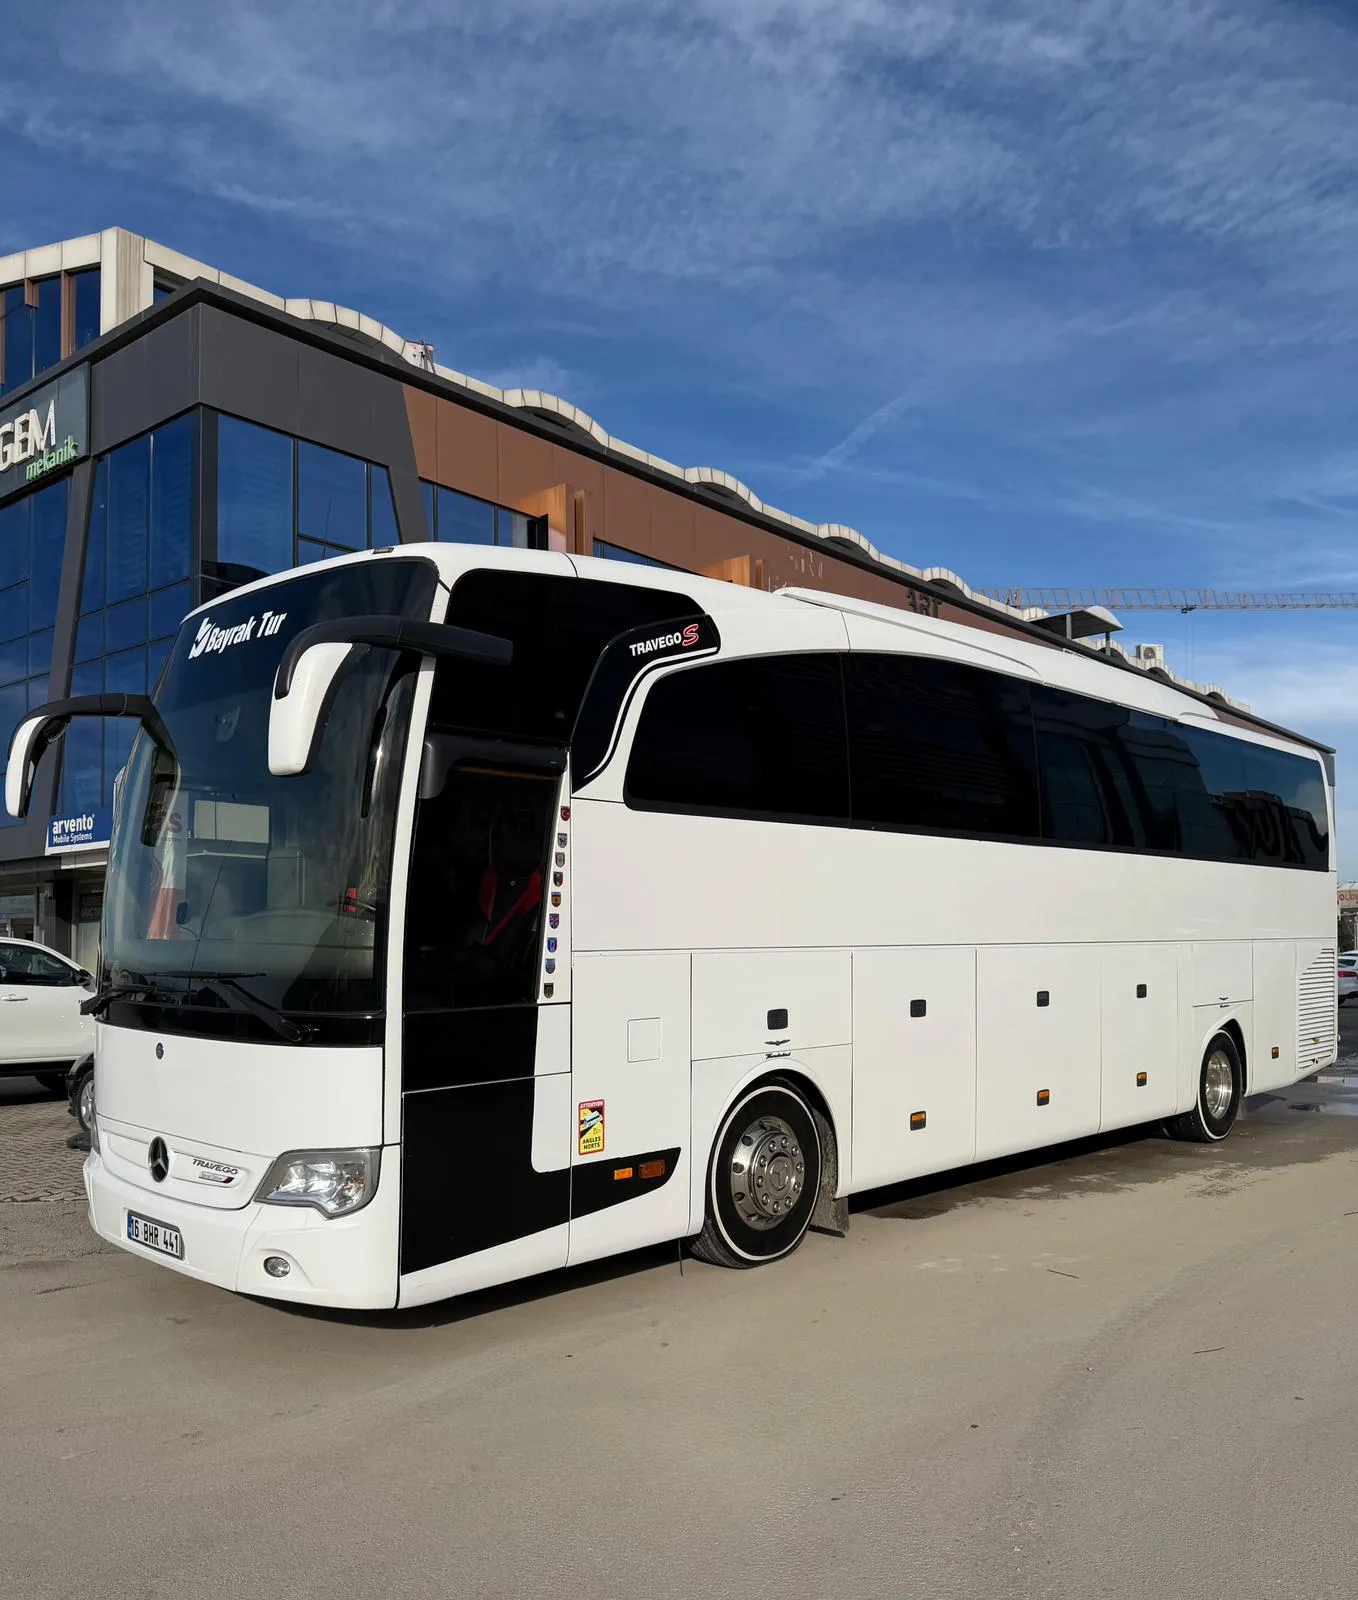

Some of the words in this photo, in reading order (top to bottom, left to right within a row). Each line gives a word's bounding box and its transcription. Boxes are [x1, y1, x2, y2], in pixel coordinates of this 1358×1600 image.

[26, 434, 79, 481] mekanik
[204, 616, 257, 654] Bayrak
[256, 610, 288, 638] Tur
[629, 632, 682, 657] TRAVEGO
[52, 813, 94, 835] arvento
[52, 834, 70, 844] Mobile
[70, 832, 93, 843] Systems
[192, 1158, 239, 1175] TRAVEGO
[143, 1222, 159, 1247] BHR
[163, 1229, 179, 1254] 441
